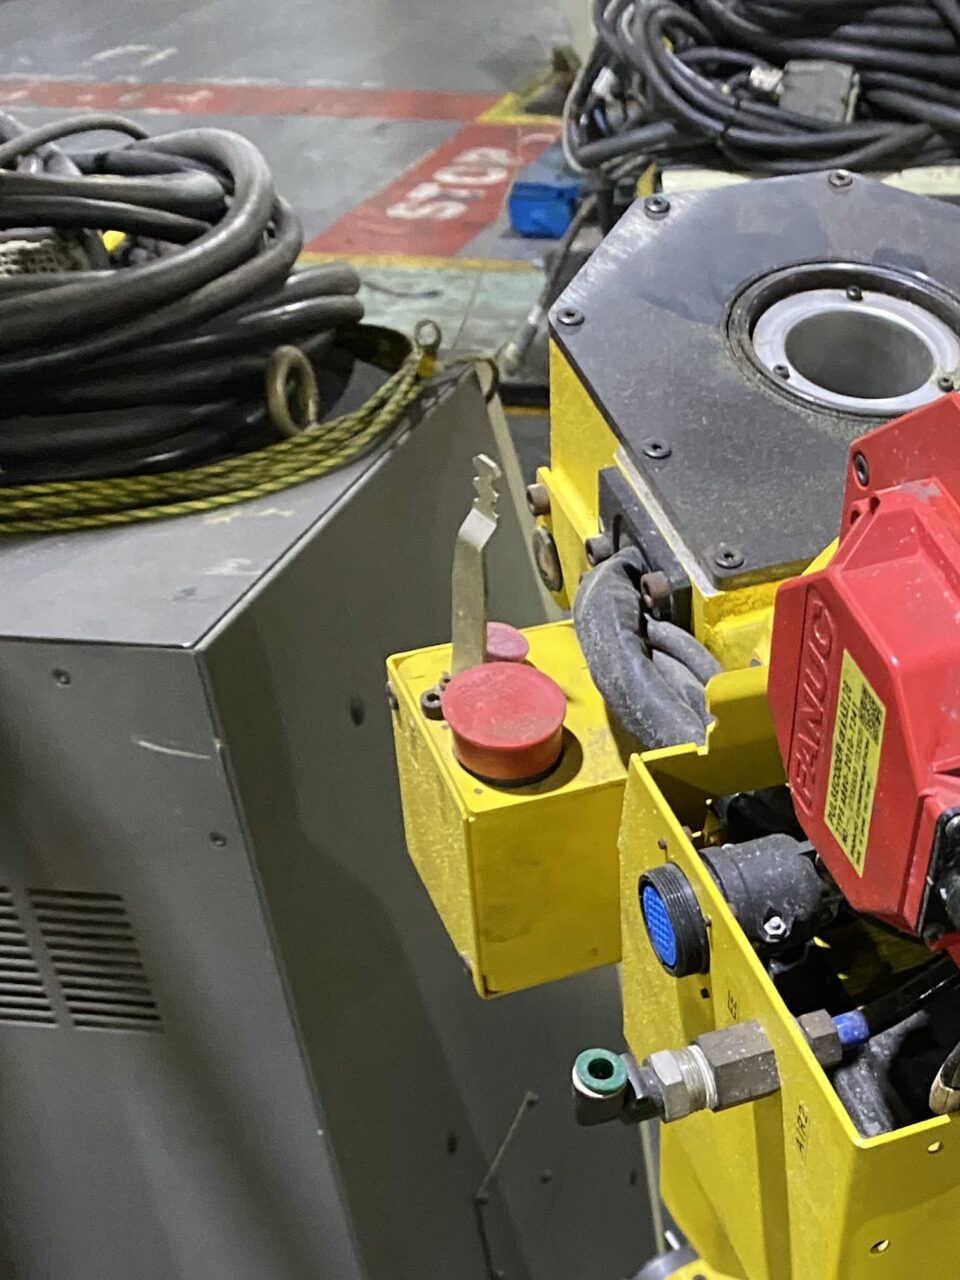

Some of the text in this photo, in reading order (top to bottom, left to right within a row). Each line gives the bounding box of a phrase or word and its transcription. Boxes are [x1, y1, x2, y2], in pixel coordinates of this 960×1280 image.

[386, 147, 521, 219] STOP
[793, 599, 834, 808] FANUC
[795, 1104, 809, 1153] AIR2
